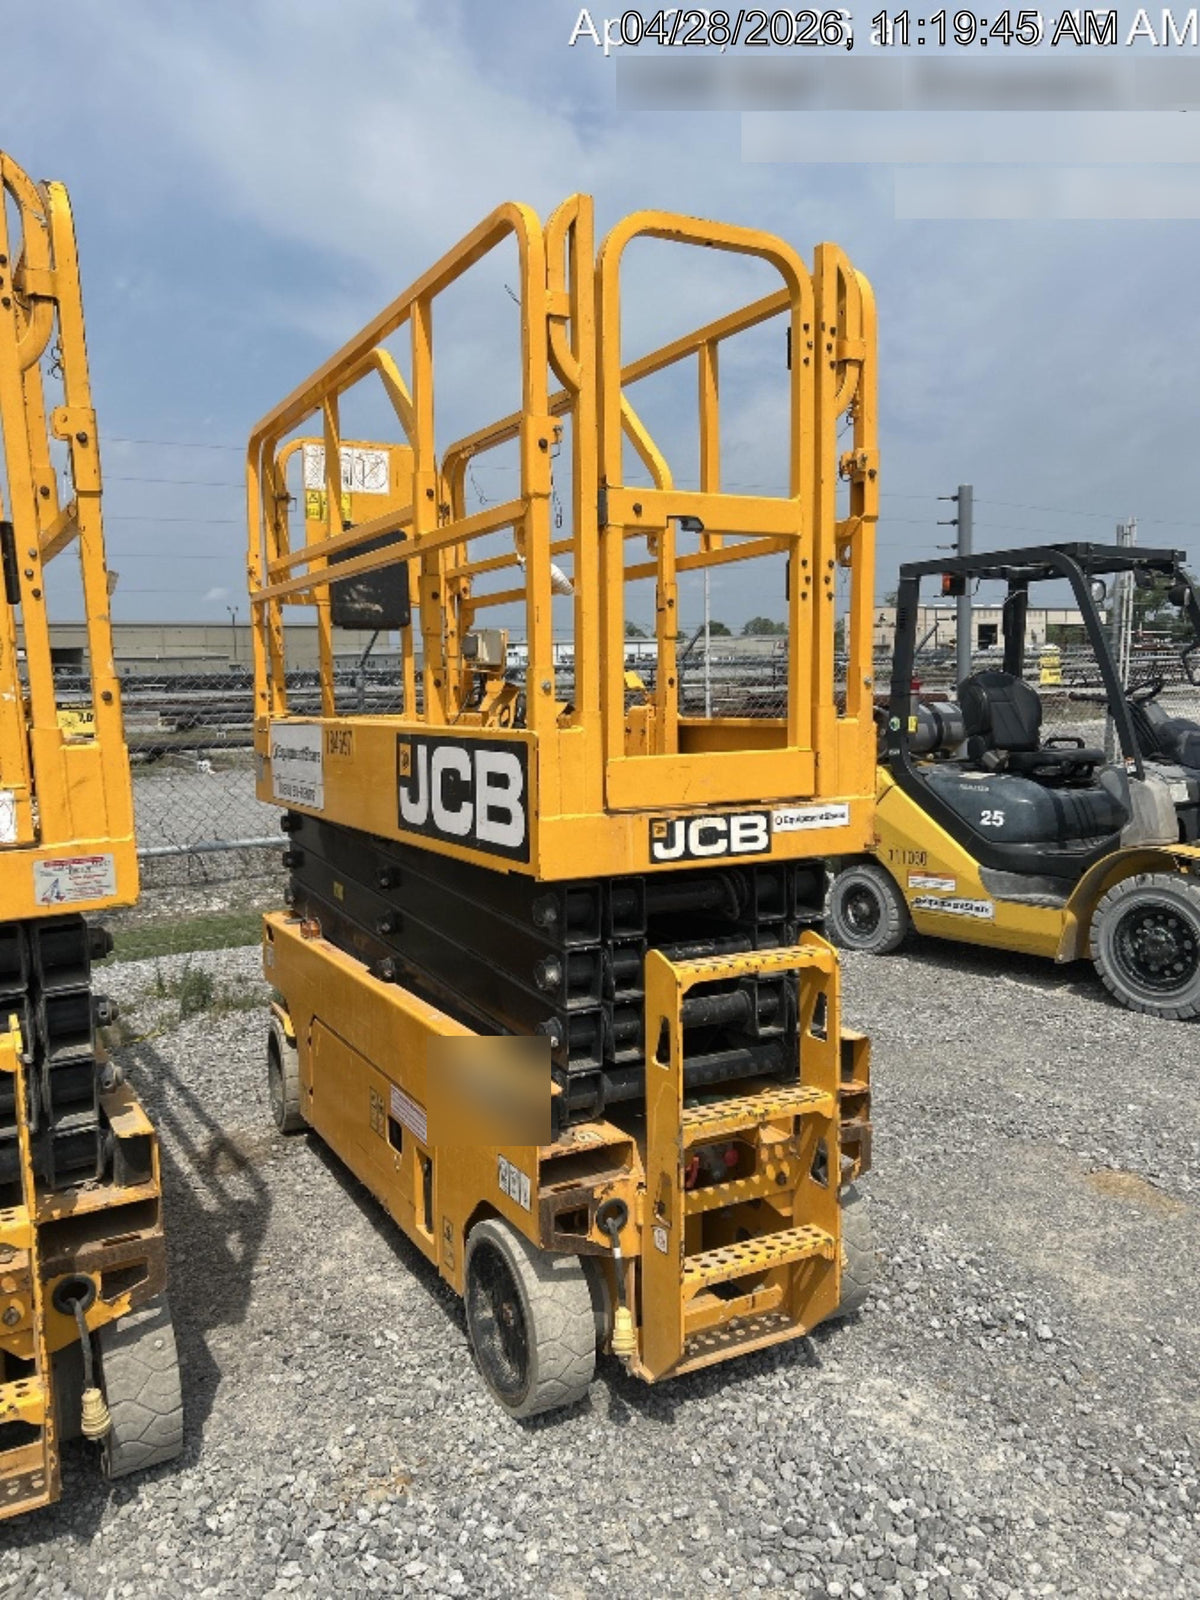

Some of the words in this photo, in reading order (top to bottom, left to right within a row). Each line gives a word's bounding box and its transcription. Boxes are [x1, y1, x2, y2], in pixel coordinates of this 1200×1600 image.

[400, 744, 525, 848] JCB
[980, 810, 1005, 827] 25
[653, 815, 769, 860] JCB
